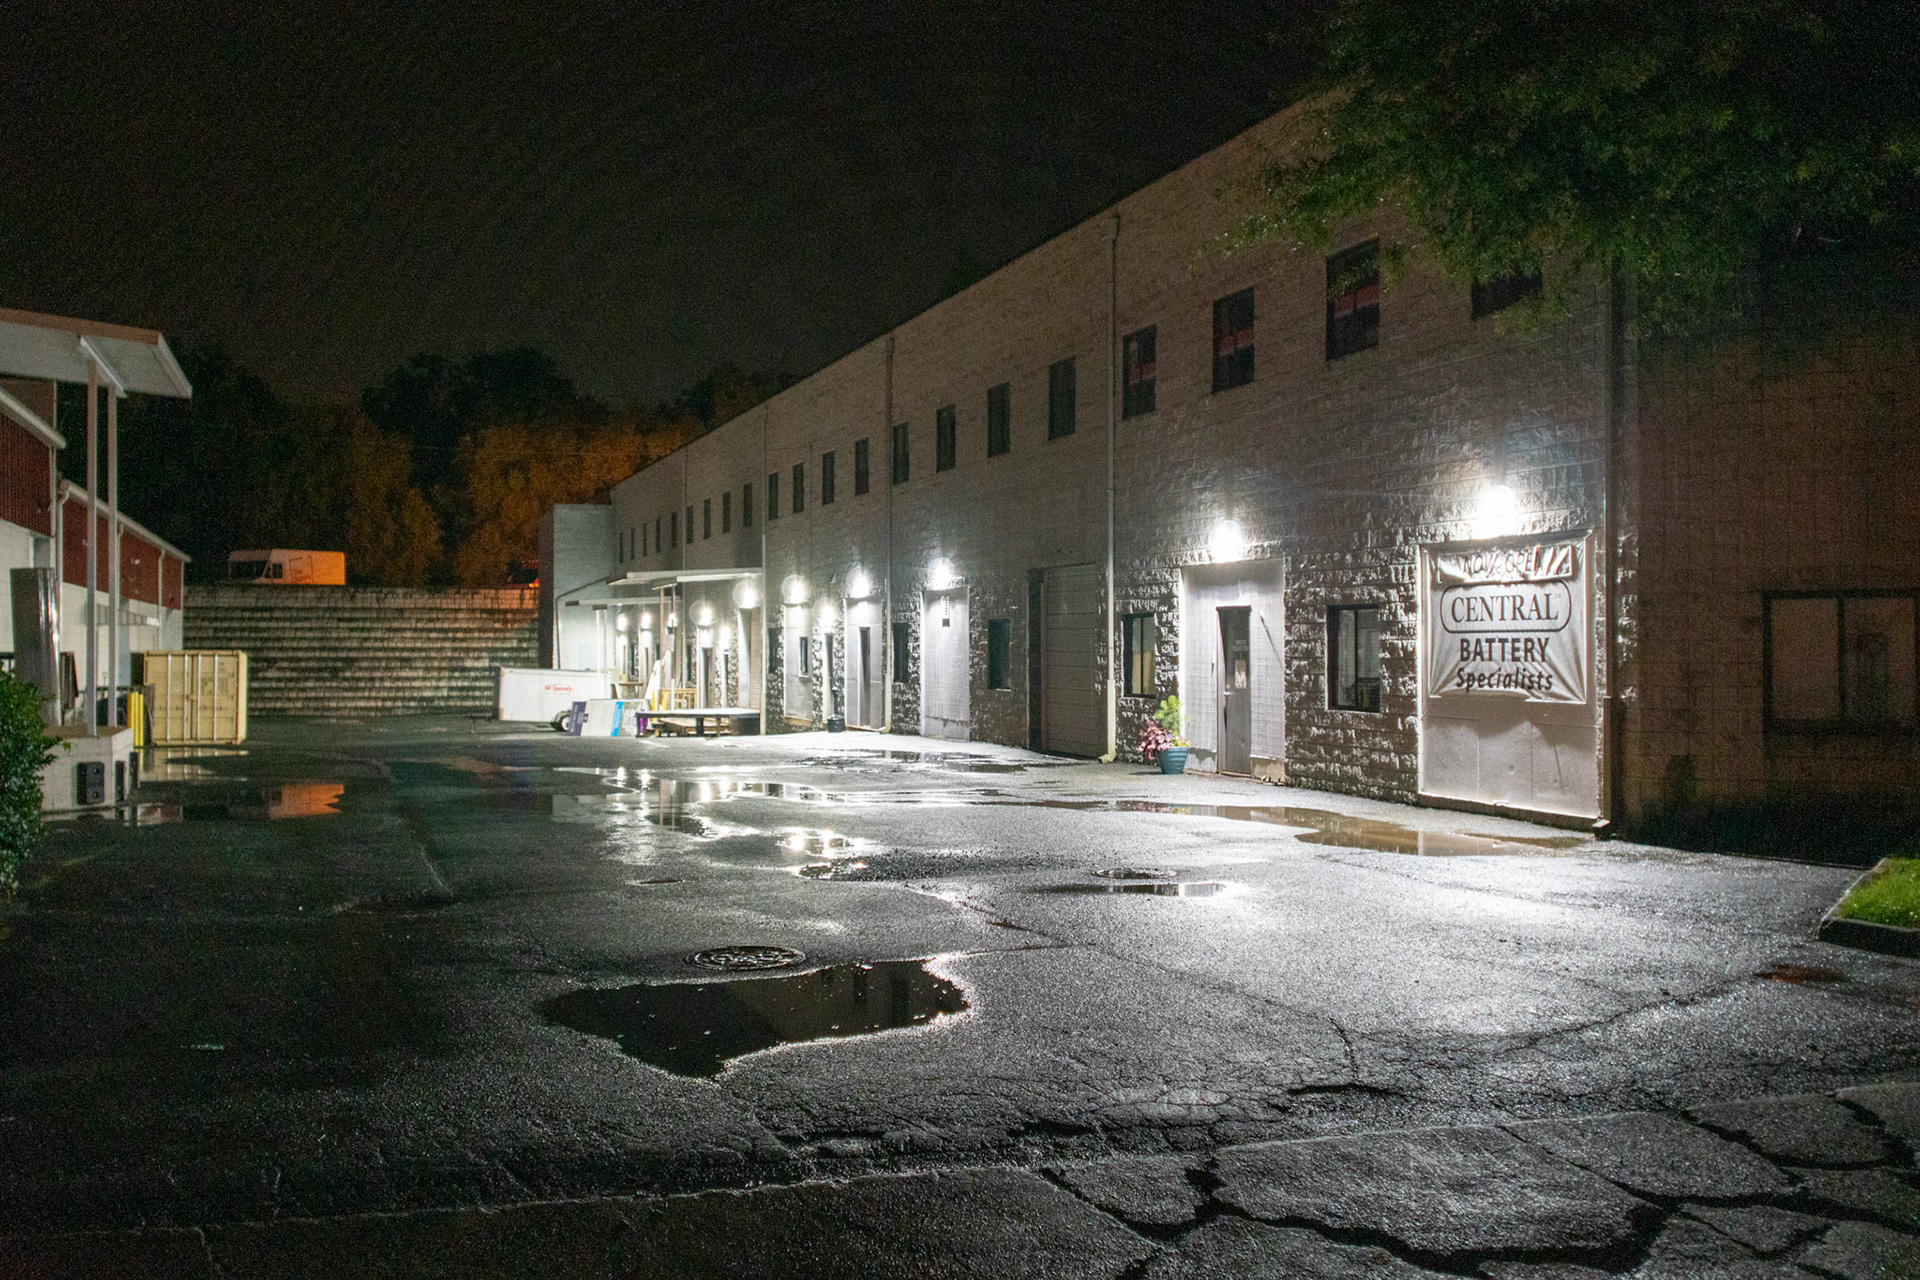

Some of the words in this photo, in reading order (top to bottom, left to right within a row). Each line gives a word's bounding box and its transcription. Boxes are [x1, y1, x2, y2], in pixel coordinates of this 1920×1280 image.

[1451, 593, 1558, 622] CENTRAL
[1460, 637, 1549, 662] BATTERY
[1456, 667, 1553, 692] Specialists
